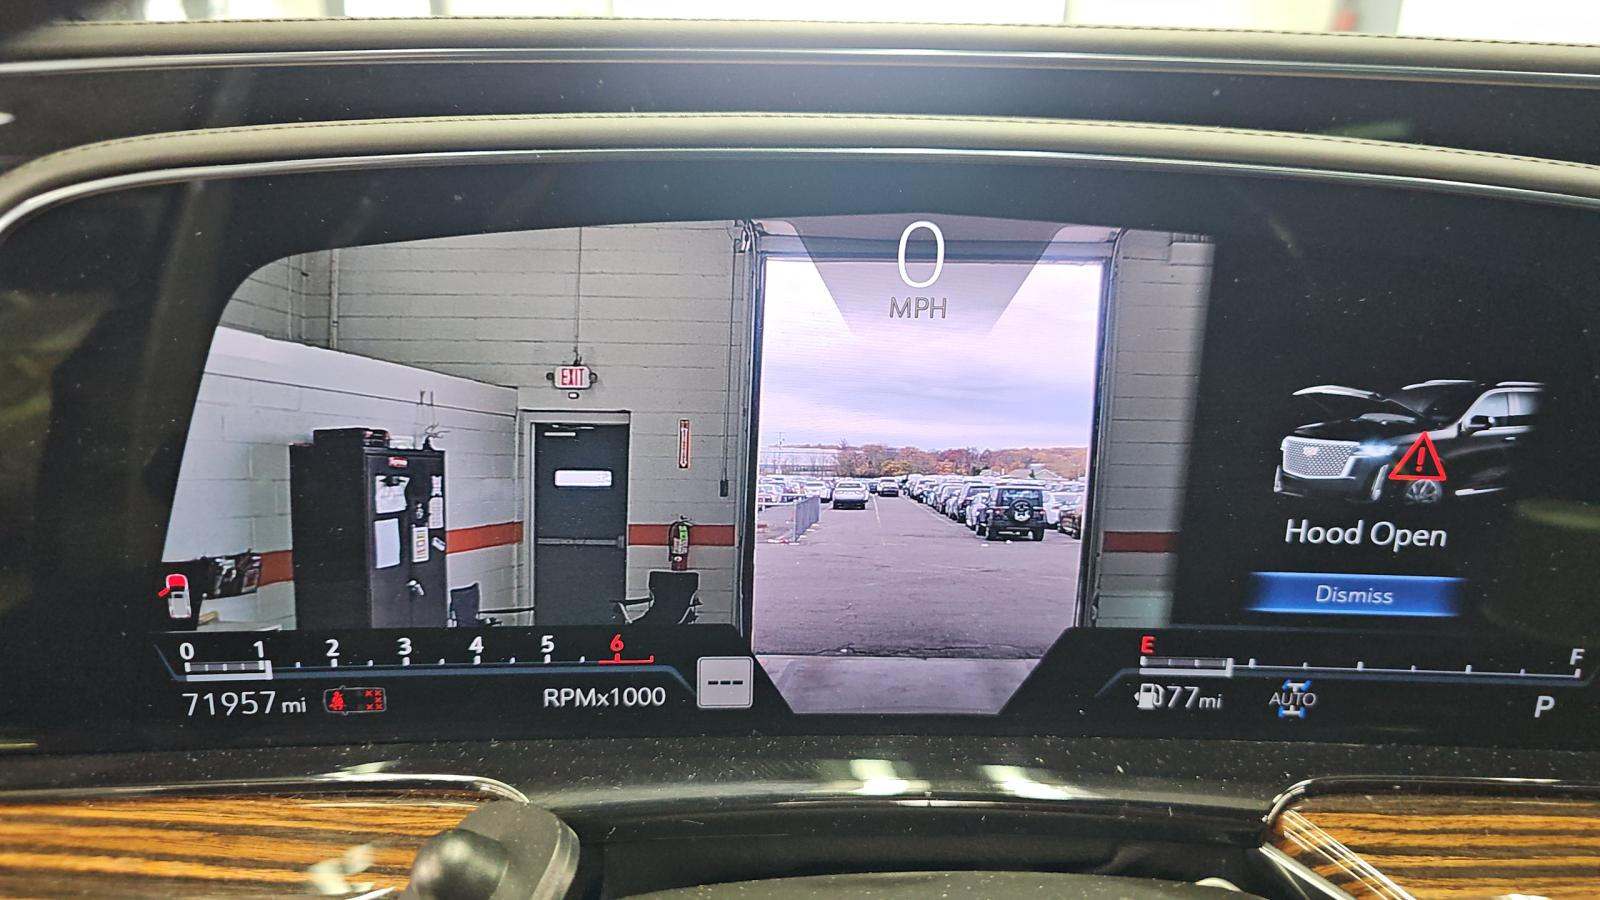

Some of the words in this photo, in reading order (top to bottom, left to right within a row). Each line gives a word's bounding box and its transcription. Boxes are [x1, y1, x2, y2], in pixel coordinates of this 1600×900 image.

[898, 220, 945, 288] 0
[889, 296, 947, 319] MPH
[561, 367, 585, 386] EXIT
[1284, 518, 1366, 545] Hood
[1370, 520, 1448, 553] Open
[1315, 584, 1394, 605] Dismiss
[179, 642, 195, 660] 0
[252, 640, 265, 659] 1
[325, 638, 340, 657] 2
[396, 637, 412, 655] 3
[468, 635, 484, 654] 4
[541, 635, 555, 653] 5
[609, 633, 625, 652] 6
[1139, 635, 1156, 654] E
[1569, 648, 1585, 666] F
[182, 690, 276, 717] 71957
[281, 697, 307, 714] mi
[543, 686, 666, 708] RPMx1000
[1166, 685, 1199, 709] 77
[1199, 693, 1223, 710] mi
[1268, 691, 1317, 708] AUTO
[1534, 694, 1555, 719] P
